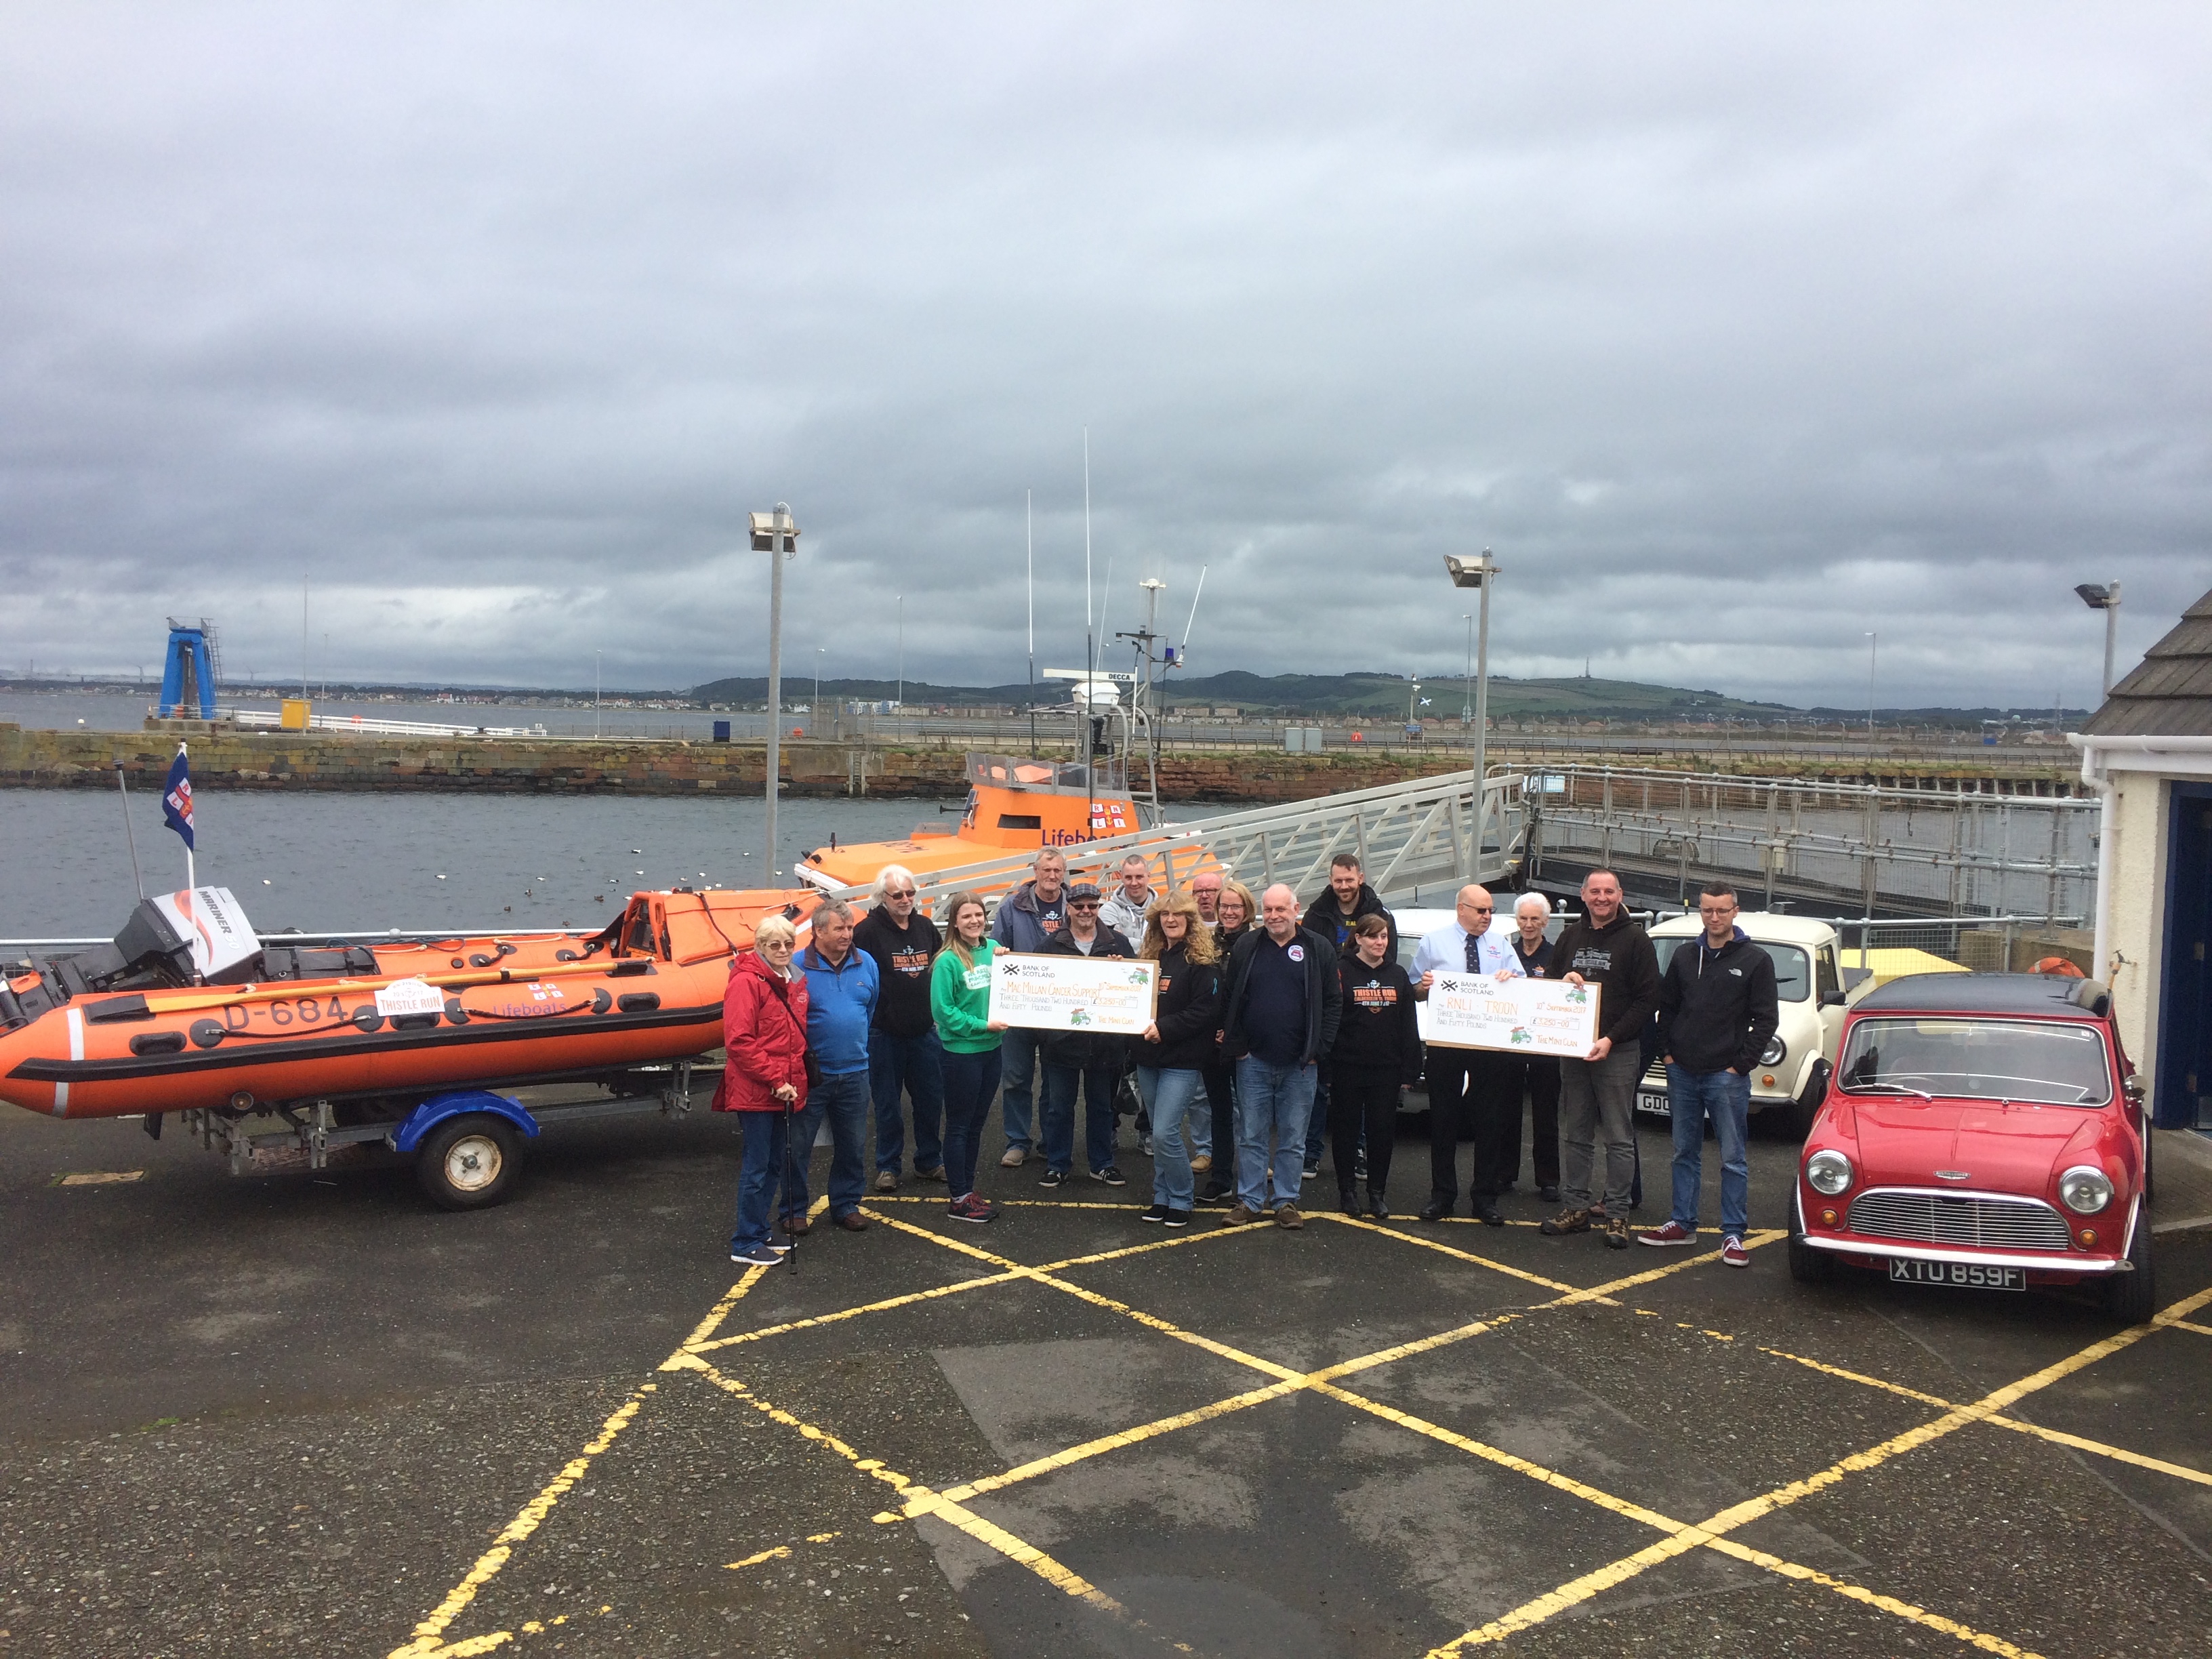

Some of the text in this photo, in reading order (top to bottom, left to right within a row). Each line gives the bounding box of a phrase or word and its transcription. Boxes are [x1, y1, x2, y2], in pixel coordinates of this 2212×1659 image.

[199, 890, 240, 949] MARINER 50
[916, 953, 928, 962] RUN
[1353, 989, 1396, 997] THISTLE RUN
[380, 995, 441, 1012] THISTLE RUN
[1447, 997, 1519, 1016] RNLI TROON
[1573, 1006, 1586, 1014] 2017
[223, 996, 348, 1031] D-684
[1437, 1008, 1454, 1017] THREE
[1894, 1258, 2020, 1287] XTU 859F
